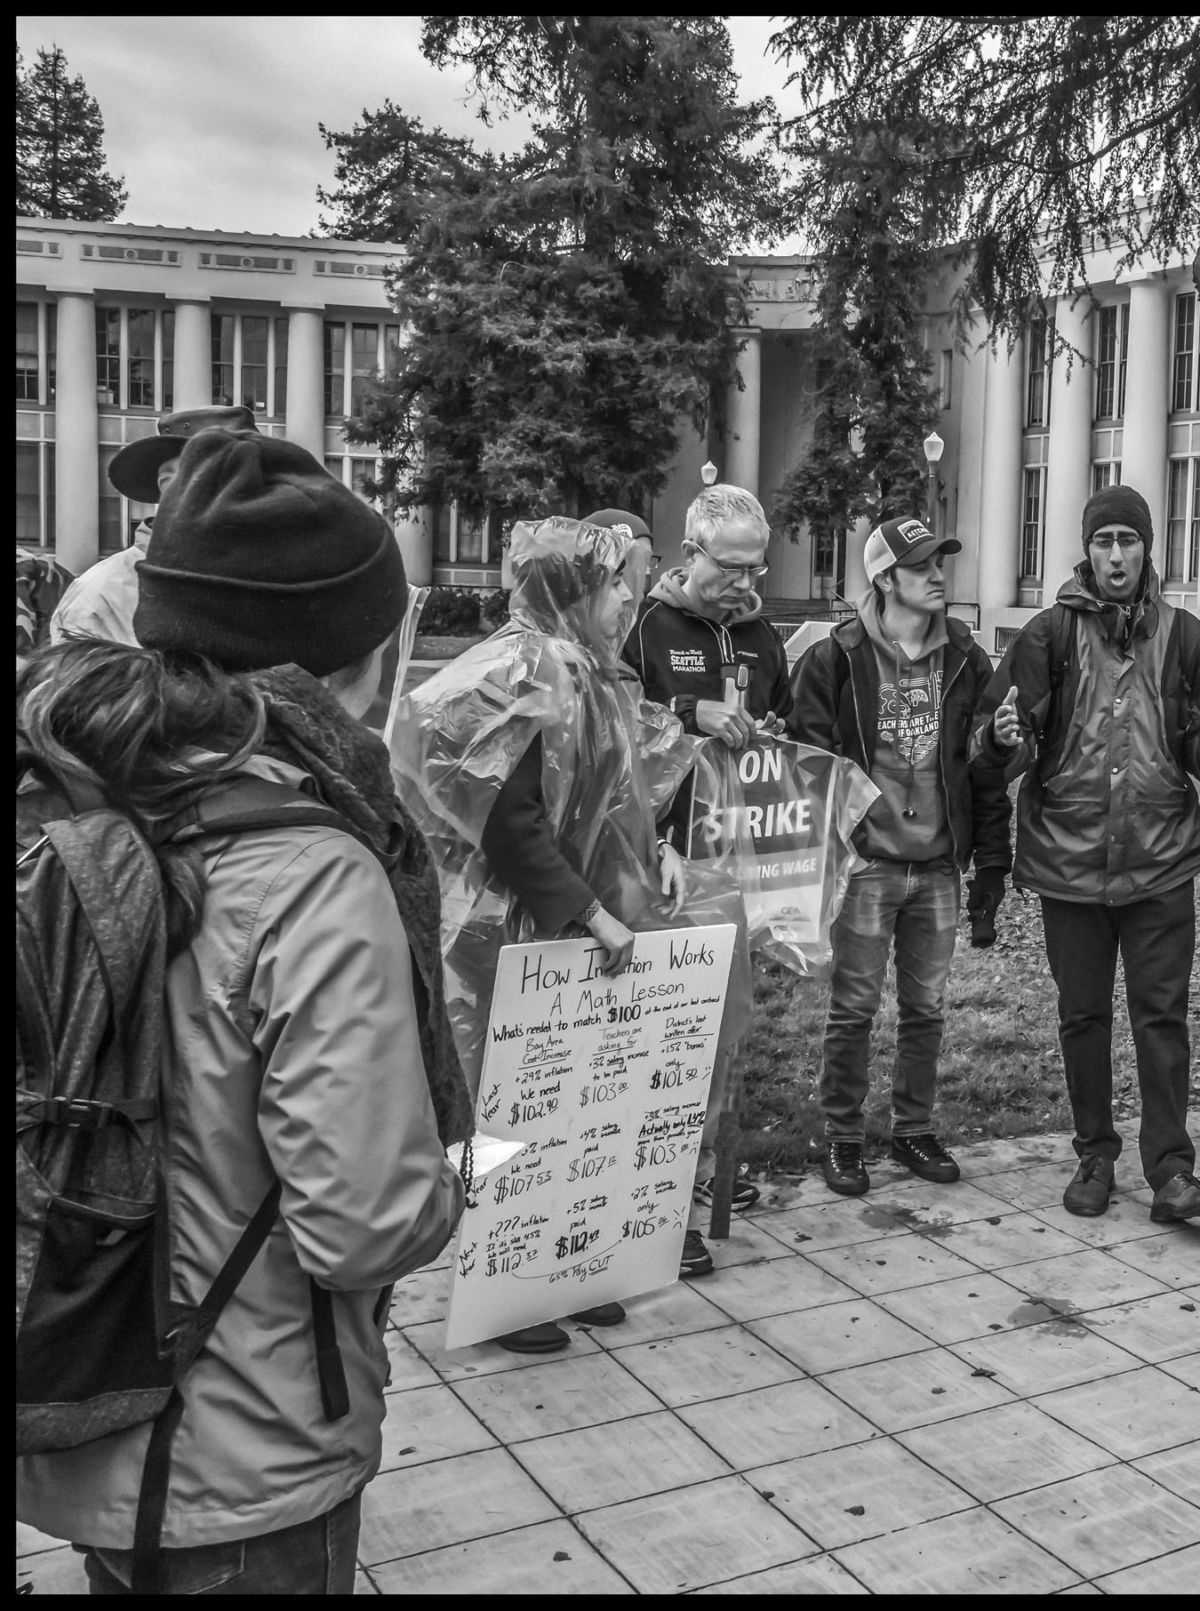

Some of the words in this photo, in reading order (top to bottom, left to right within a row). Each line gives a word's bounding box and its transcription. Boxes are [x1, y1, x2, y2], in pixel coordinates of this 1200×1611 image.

[670, 655, 706, 666] SEATTLE
[672, 665, 706, 673] MARATHON
[738, 748, 782, 784] ON
[704, 799, 811, 843] STRIKE
[782, 858, 817, 876] WAGE
[521, 954, 570, 994] How
[578, 947, 652, 983] Intion
[669, 939, 715, 970] Works
[550, 992, 562, 1017] A
[576, 988, 618, 1014] Math
[631, 981, 684, 1003] Lesson
[526, 1020, 552, 1035] needed
[555, 1019, 568, 1031] to
[573, 1013, 602, 1029] match
[606, 1004, 641, 1024] $100
[525, 1037, 545, 1058] Bay
[520, 1088, 535, 1100] We
[540, 1080, 561, 1097] need
[525, 1157, 541, 1170] need
[589, 1254, 615, 1272] CUT
